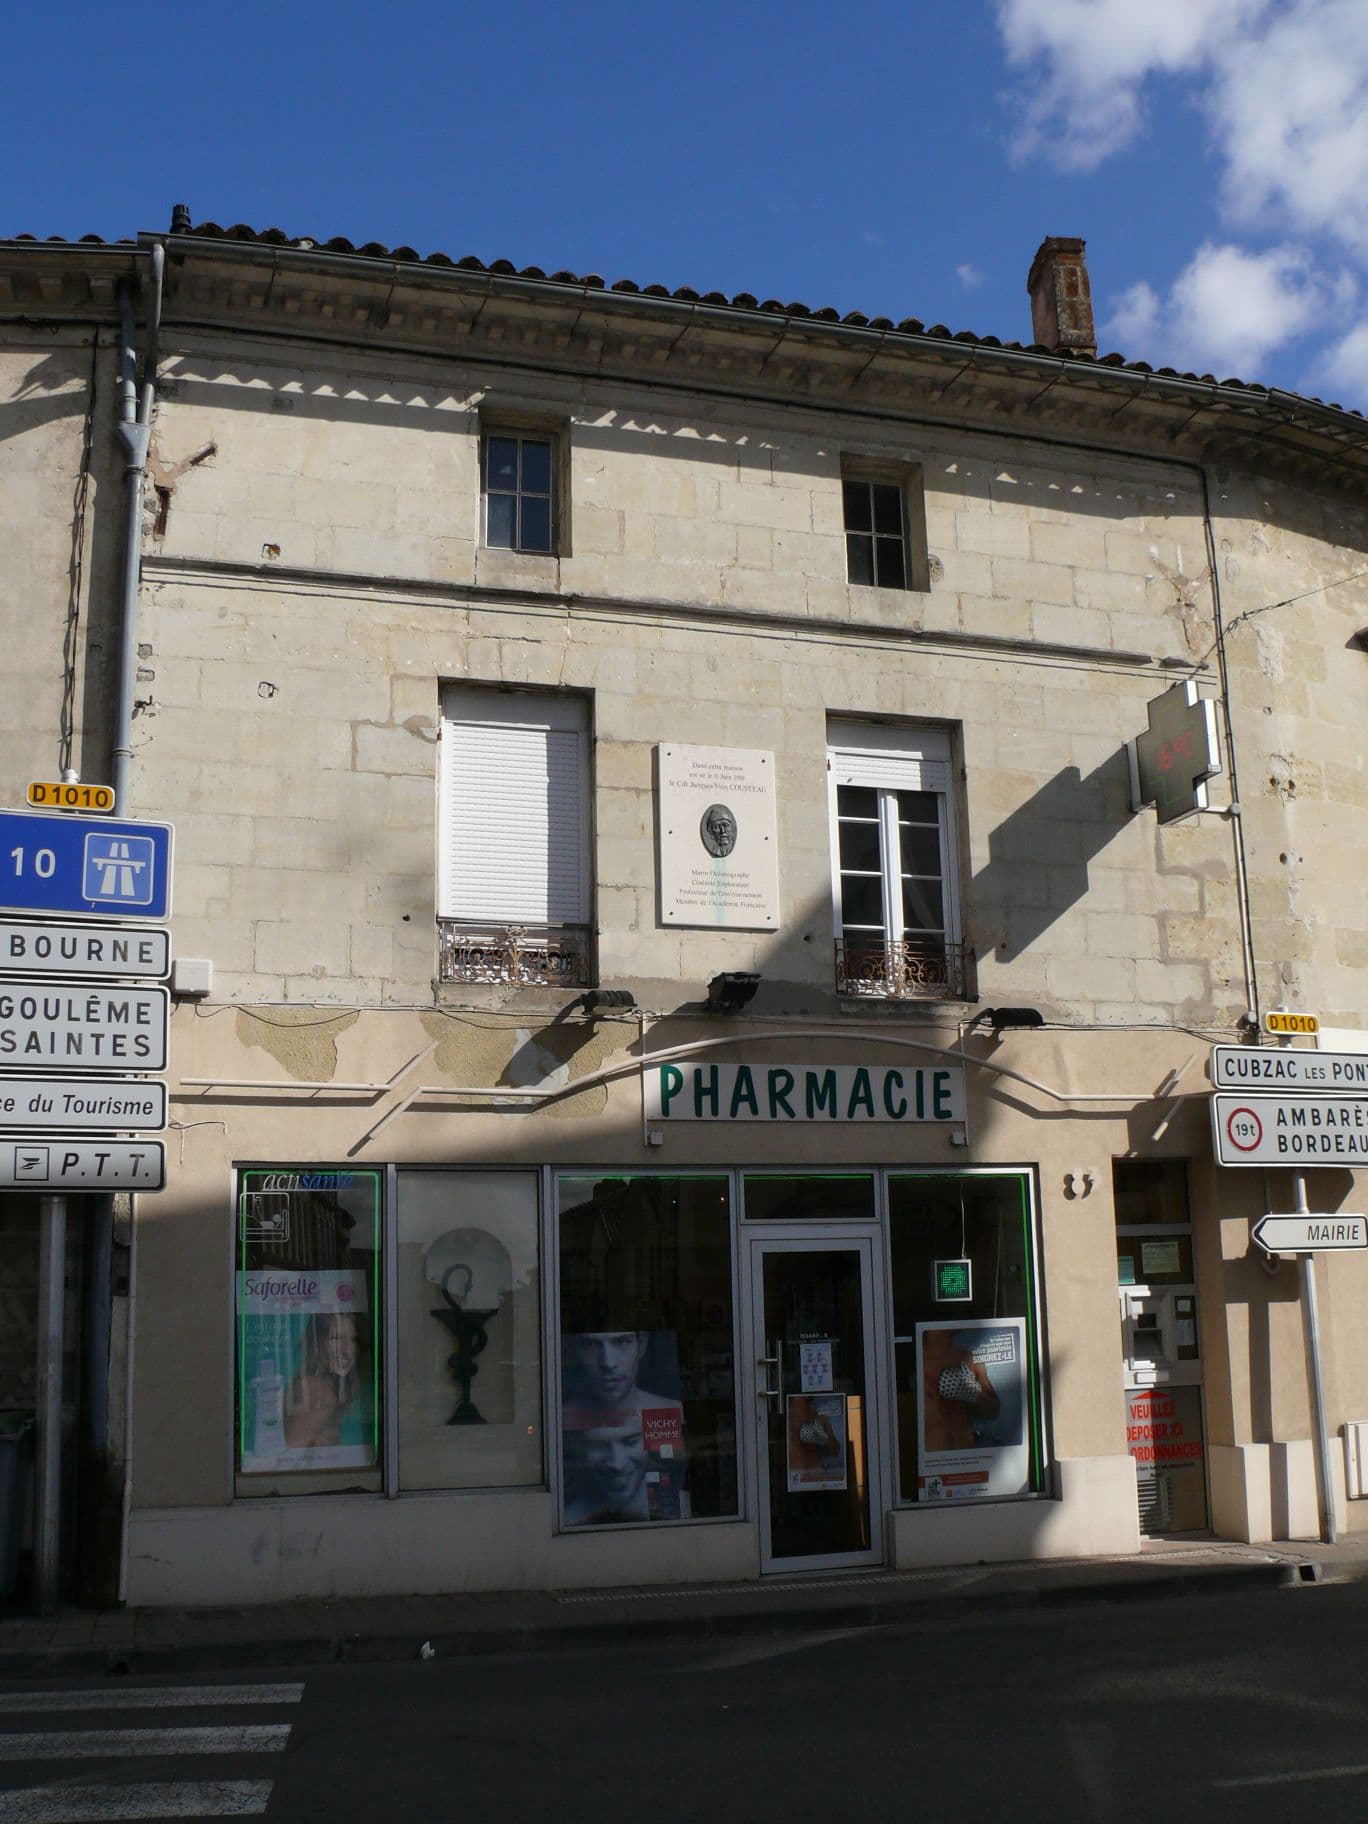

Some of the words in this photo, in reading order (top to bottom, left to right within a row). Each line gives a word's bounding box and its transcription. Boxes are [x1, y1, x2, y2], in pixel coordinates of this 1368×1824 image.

[692, 762, 708, 770] Dans
[33, 784, 109, 808] D1010
[669, 779, 675, 787] le
[729, 784, 767, 793] COUSTEAU
[11, 847, 56, 878] 10
[10, 934, 153, 963] BOURNE
[0, 994, 151, 1025] GOULÊME
[1270, 1015, 1316, 1033] D1010
[0, 1029, 151, 1057] SAINTES
[1225, 1057, 1298, 1079] CUBZAC
[1304, 1067, 1326, 1080] LES
[659, 1064, 953, 1120] PHARMACIE
[28, 1093, 53, 1113] du
[63, 1094, 154, 1115] Tourisme
[1277, 1105, 1368, 1127] AMBARÈ
[1307, 1225, 1360, 1241] MAIRIE
[244, 1278, 318, 1301] Saforelle
[644, 1430, 681, 1440] HOMME
[647, 1419, 677, 1429] VICHY
